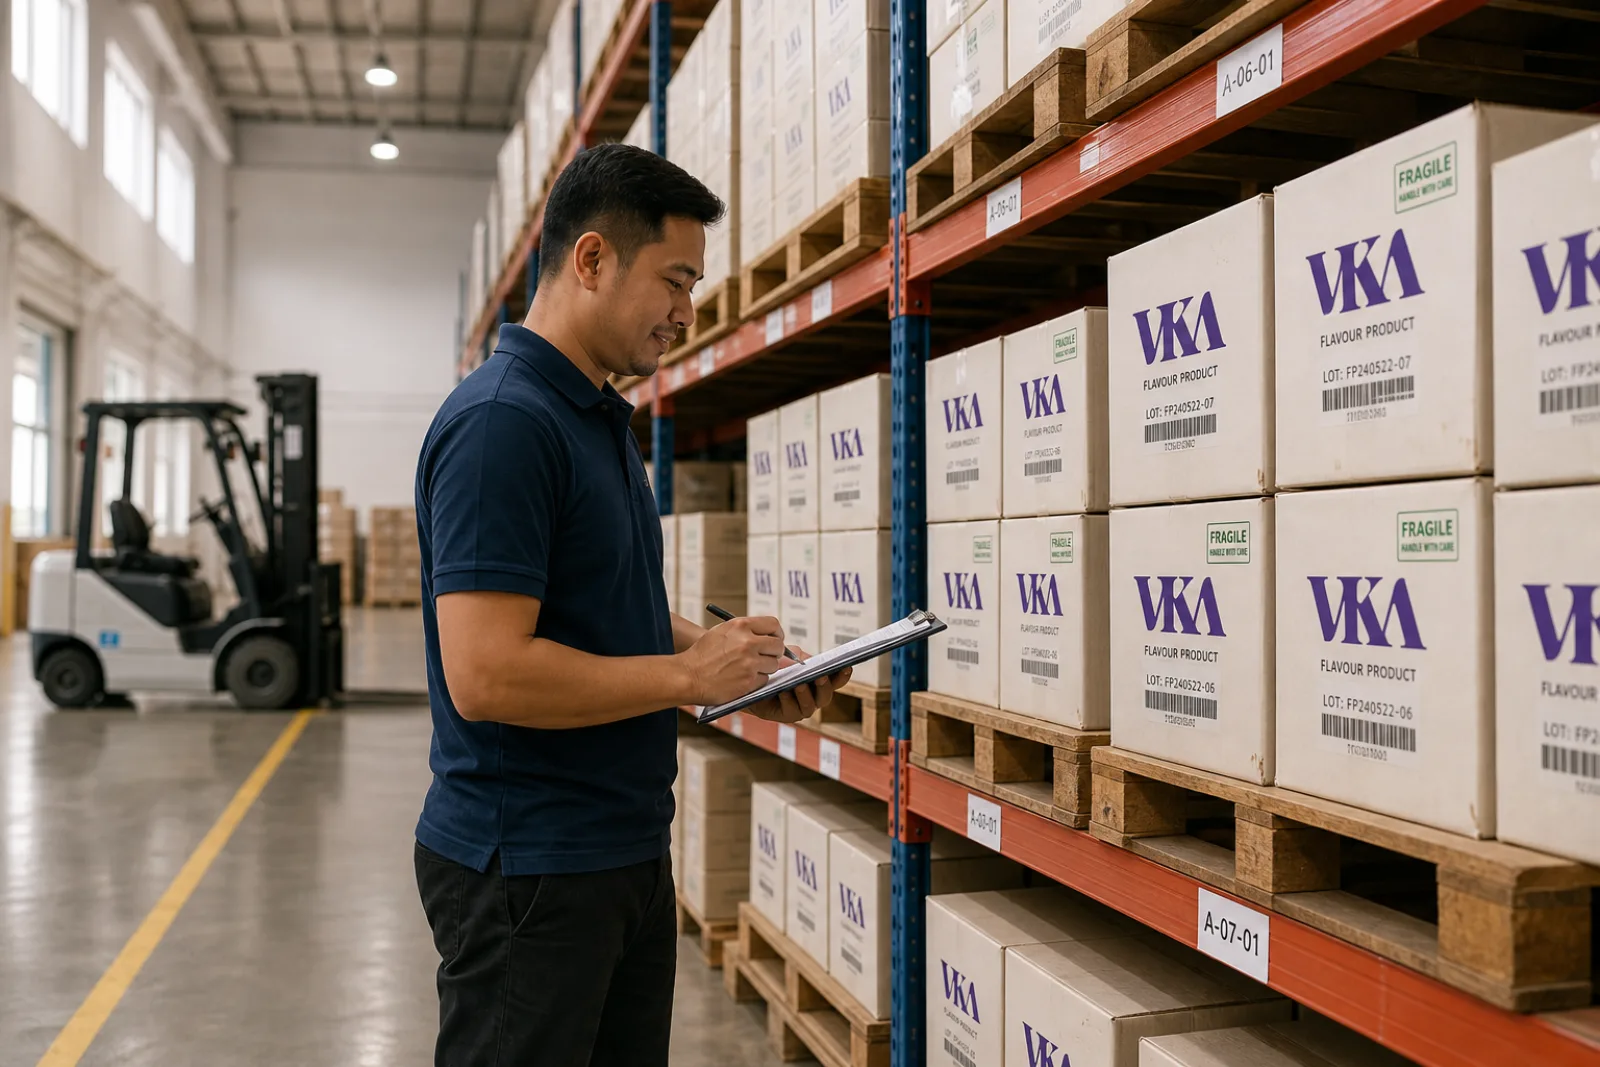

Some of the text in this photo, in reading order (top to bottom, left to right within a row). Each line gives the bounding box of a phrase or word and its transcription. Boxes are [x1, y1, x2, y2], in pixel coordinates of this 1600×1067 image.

[1222, 49, 1273, 97] A-06-01
[1399, 153, 1452, 188] FRAGILE
[1306, 228, 1425, 316] VKA
[1133, 291, 1225, 365] VKA
[1320, 316, 1415, 348] FLAVOUR PRODUCT
[1539, 325, 1592, 347] FLAVOUR
[1143, 365, 1218, 391] FLAVOUR PRODUCT
[1323, 355, 1412, 383] LOT: FP240522-07
[1541, 366, 1568, 384] LOT:
[942, 393, 984, 433] VKA
[1020, 374, 1066, 420] VKA
[1146, 396, 1215, 420] LOT: FP240522-07
[1210, 529, 1247, 543] FRAGILE
[1402, 519, 1453, 537] FRAGILE
[830, 571, 865, 604] VKA
[943, 572, 984, 610] VKA
[1016, 574, 1064, 617] VKA
[1134, 576, 1226, 637] VKA
[1307, 576, 1427, 650] VKA
[1144, 645, 1218, 662] FLAVOUR PRODUCT
[1146, 674, 1215, 693] LOT: FP240522-06
[1320, 659, 1416, 682] FLAVOUR PRODUCT
[1541, 680, 1598, 701] FLAVOUR
[1323, 694, 1413, 720] LOT: FP240522-06
[1543, 720, 1571, 740] LOT:
[1204, 910, 1259, 957] A-07-01
[940, 958, 981, 1025] VKA
